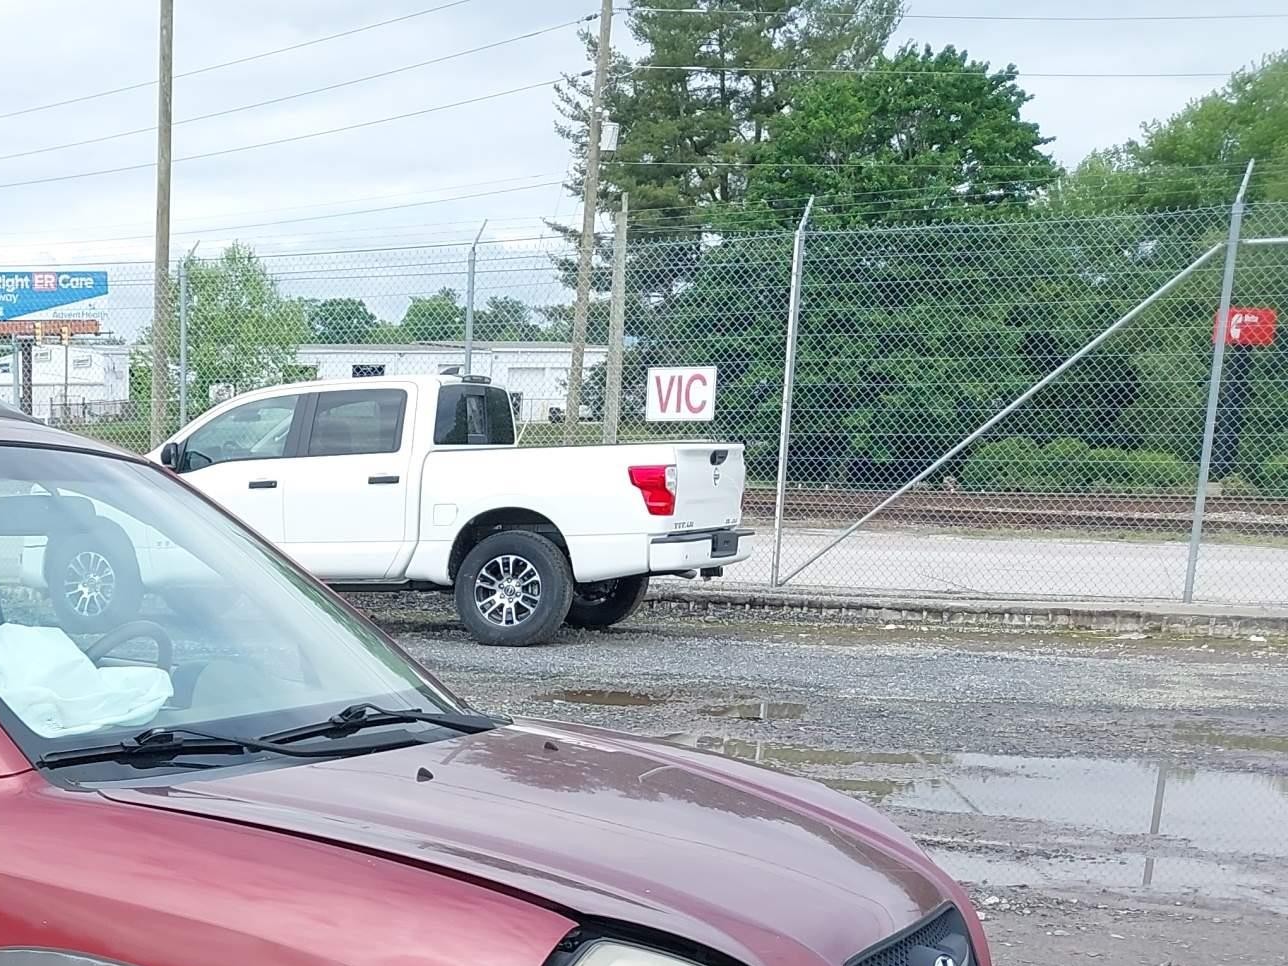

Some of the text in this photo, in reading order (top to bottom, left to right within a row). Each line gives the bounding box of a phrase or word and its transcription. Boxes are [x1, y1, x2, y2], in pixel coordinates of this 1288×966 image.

[34, 274, 56, 289] ER
[58, 274, 95, 290] Care
[655, 373, 708, 414] VIC
